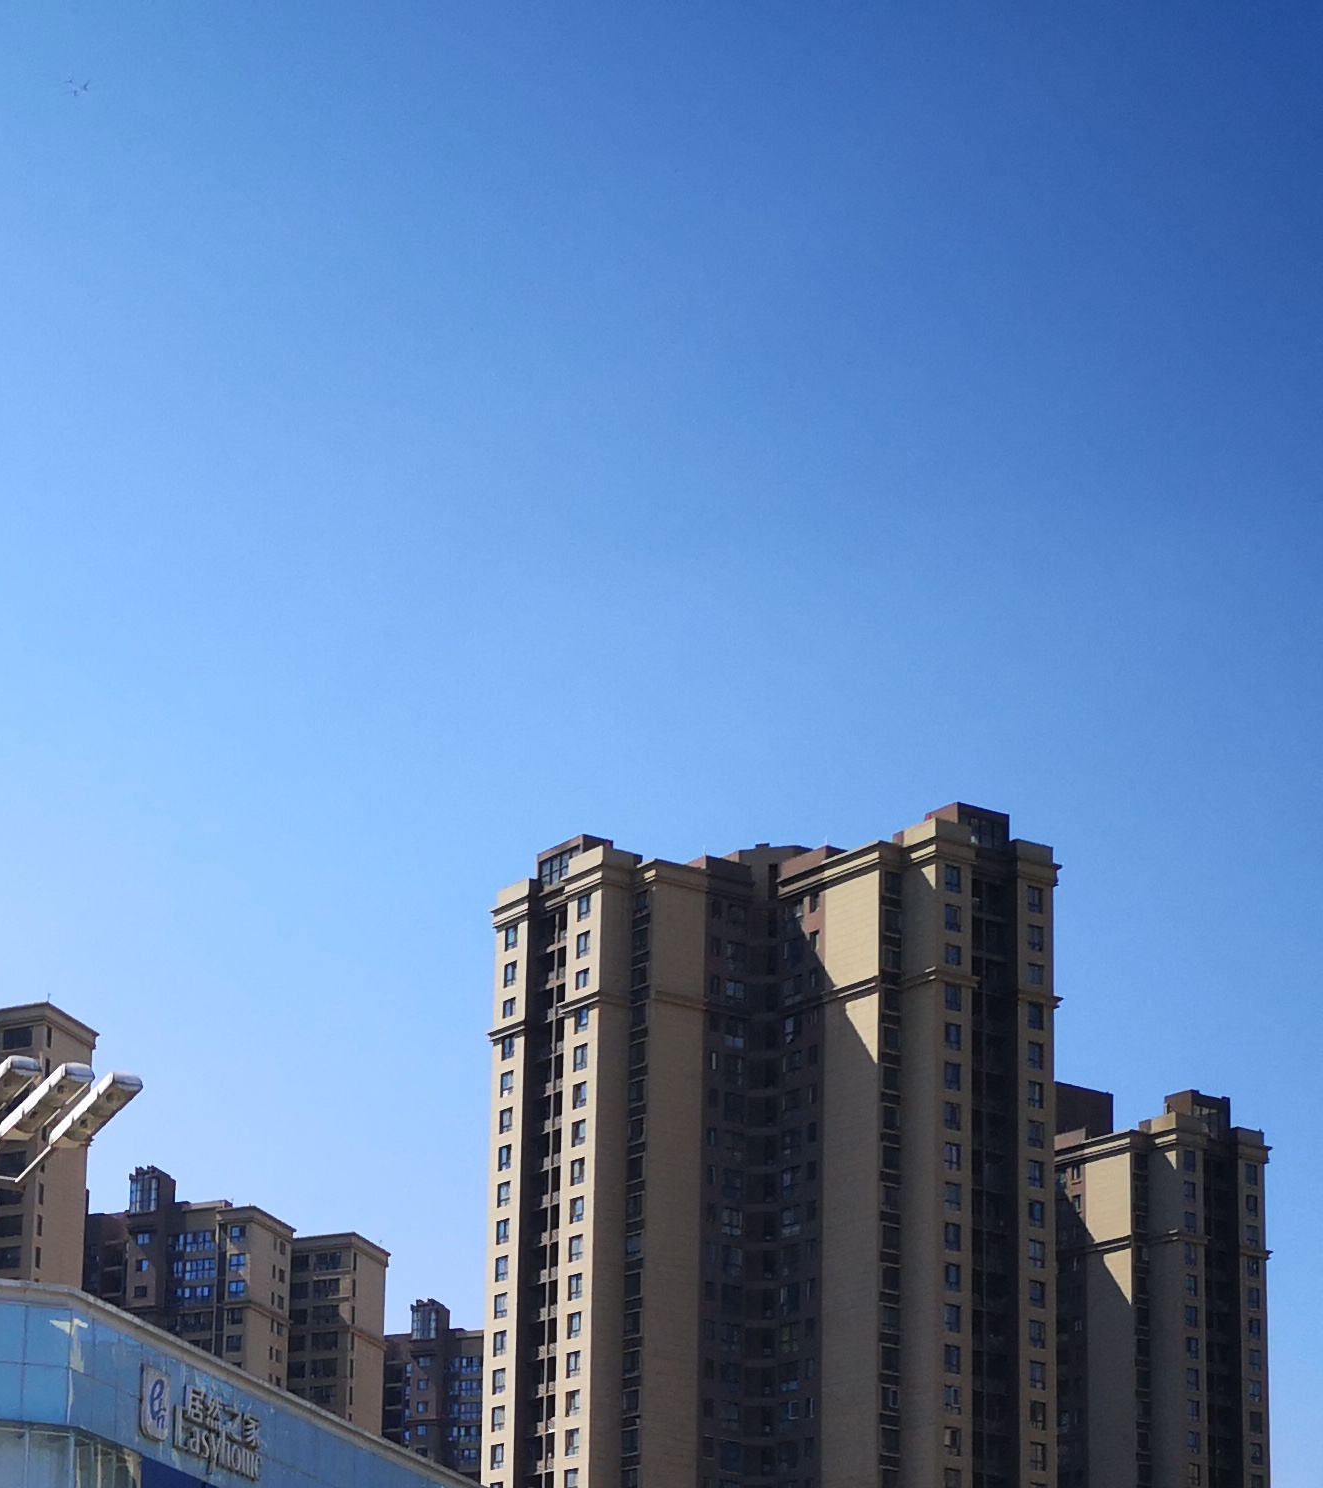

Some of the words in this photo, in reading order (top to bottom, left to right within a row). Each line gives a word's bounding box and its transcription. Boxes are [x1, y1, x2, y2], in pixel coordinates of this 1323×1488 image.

[174, 1405, 262, 1481] Easyhome
[184, 1385, 261, 1449] 居然之家
